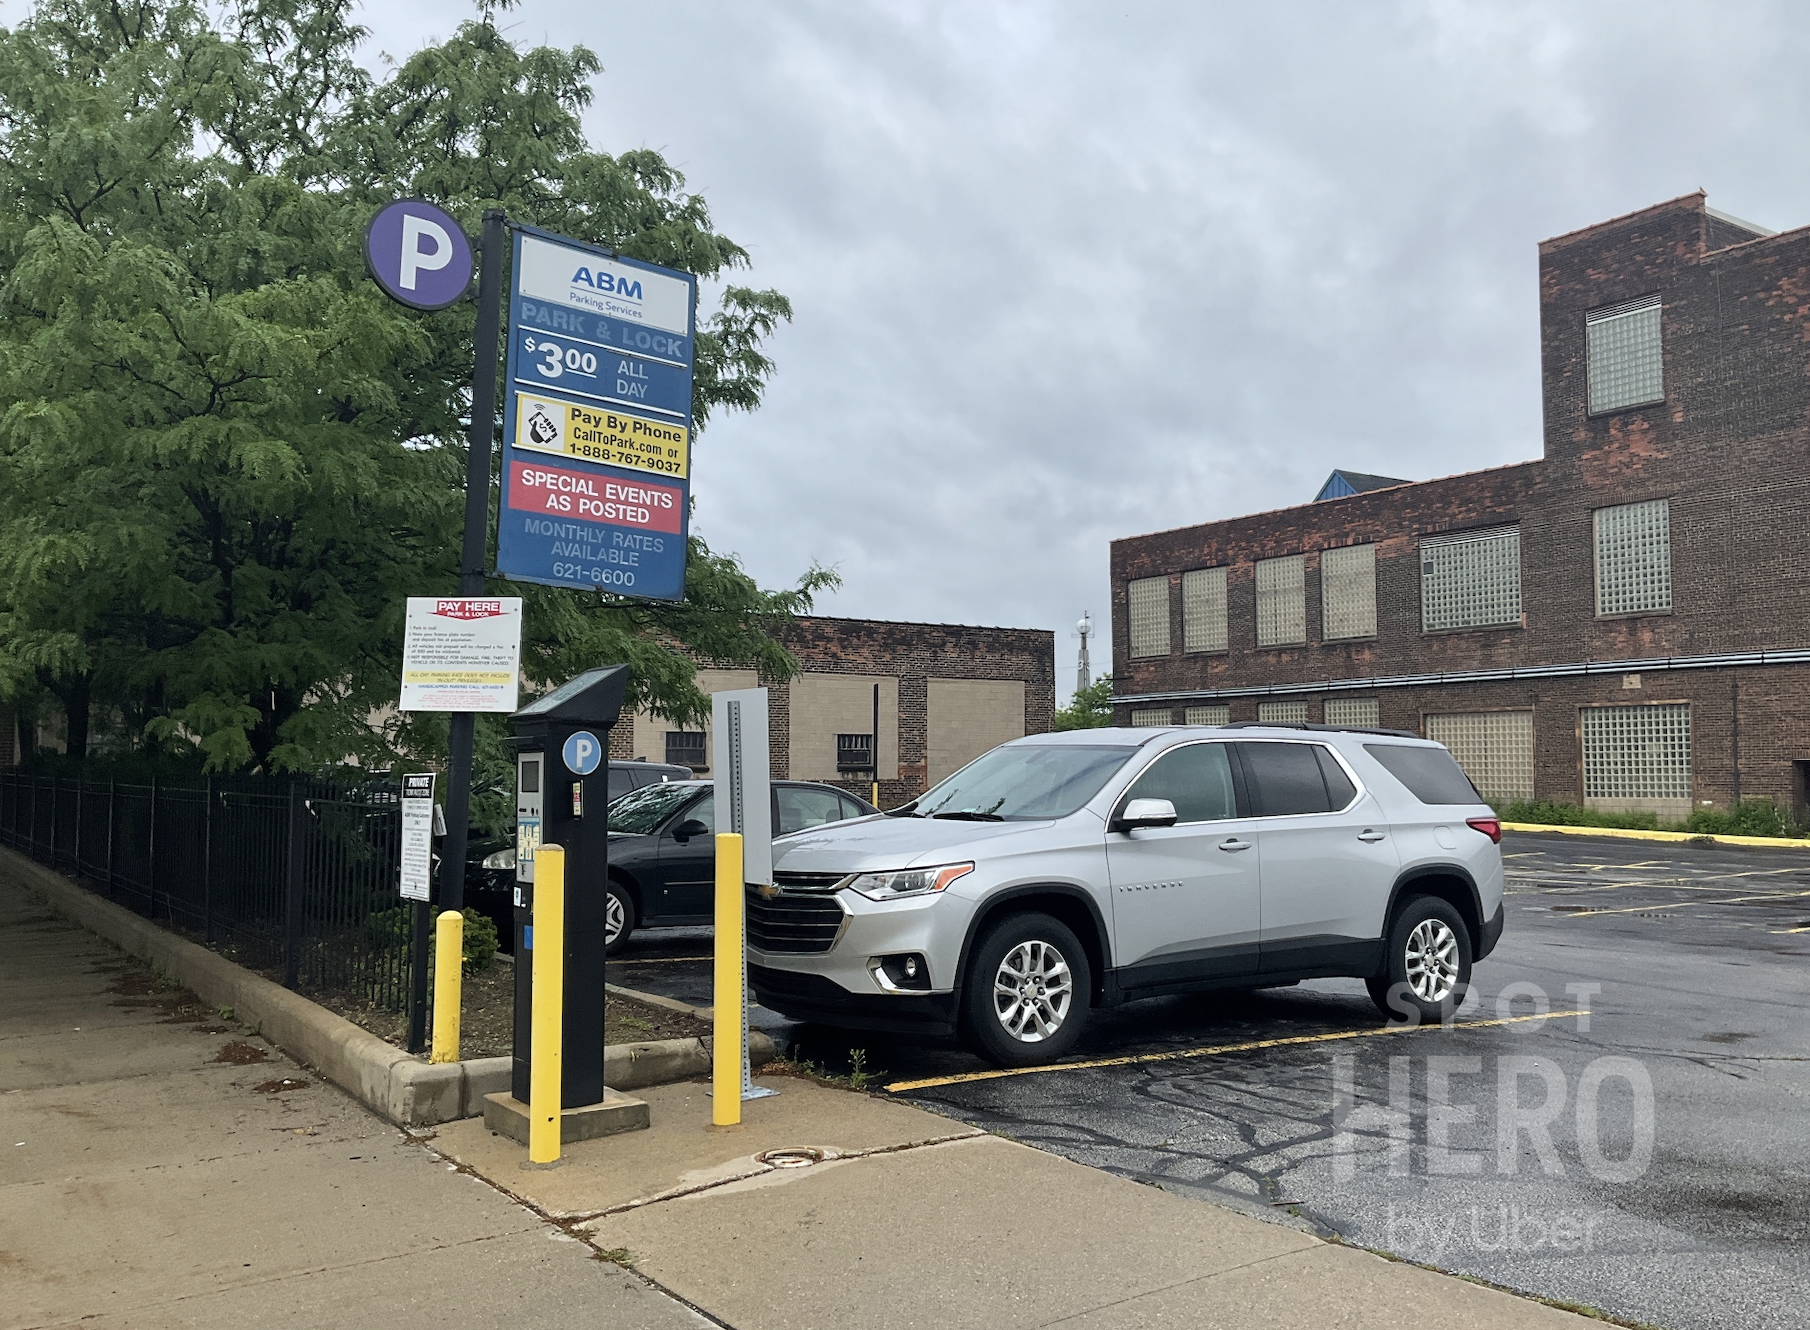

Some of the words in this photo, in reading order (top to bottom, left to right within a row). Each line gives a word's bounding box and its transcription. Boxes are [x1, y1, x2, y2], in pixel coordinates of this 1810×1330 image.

[399, 214, 453, 290] P
[571, 266, 643, 300] ABM
[569, 292, 604, 311] Parking
[605, 301, 643, 319] Services
[521, 302, 585, 335] PARK
[595, 320, 611, 340] &
[622, 327, 682, 357] LOCK
[617, 360, 648, 380] ALL
[616, 378, 648, 398] DAY
[571, 408, 602, 427] Pay
[607, 415, 628, 433] By
[633, 421, 682, 442] Phone
[573, 427, 662, 455] CallToPark.com
[667, 447, 678, 458] or
[569, 443, 681, 473] 1-888-767-9037
[521, 470, 598, 496] SPECIAL
[605, 483, 673, 509] EVENTS
[546, 494, 571, 511] AS
[579, 499, 650, 524] POSTED
[524, 518, 605, 544] MONTHLY
[613, 532, 664, 553] RATES
[551, 541, 639, 567] AVAILABLE
[553, 562, 635, 586] 621-6600
[439, 602, 461, 611] PAY
[465, 602, 500, 611] HERE
[576, 739, 592, 768] P
